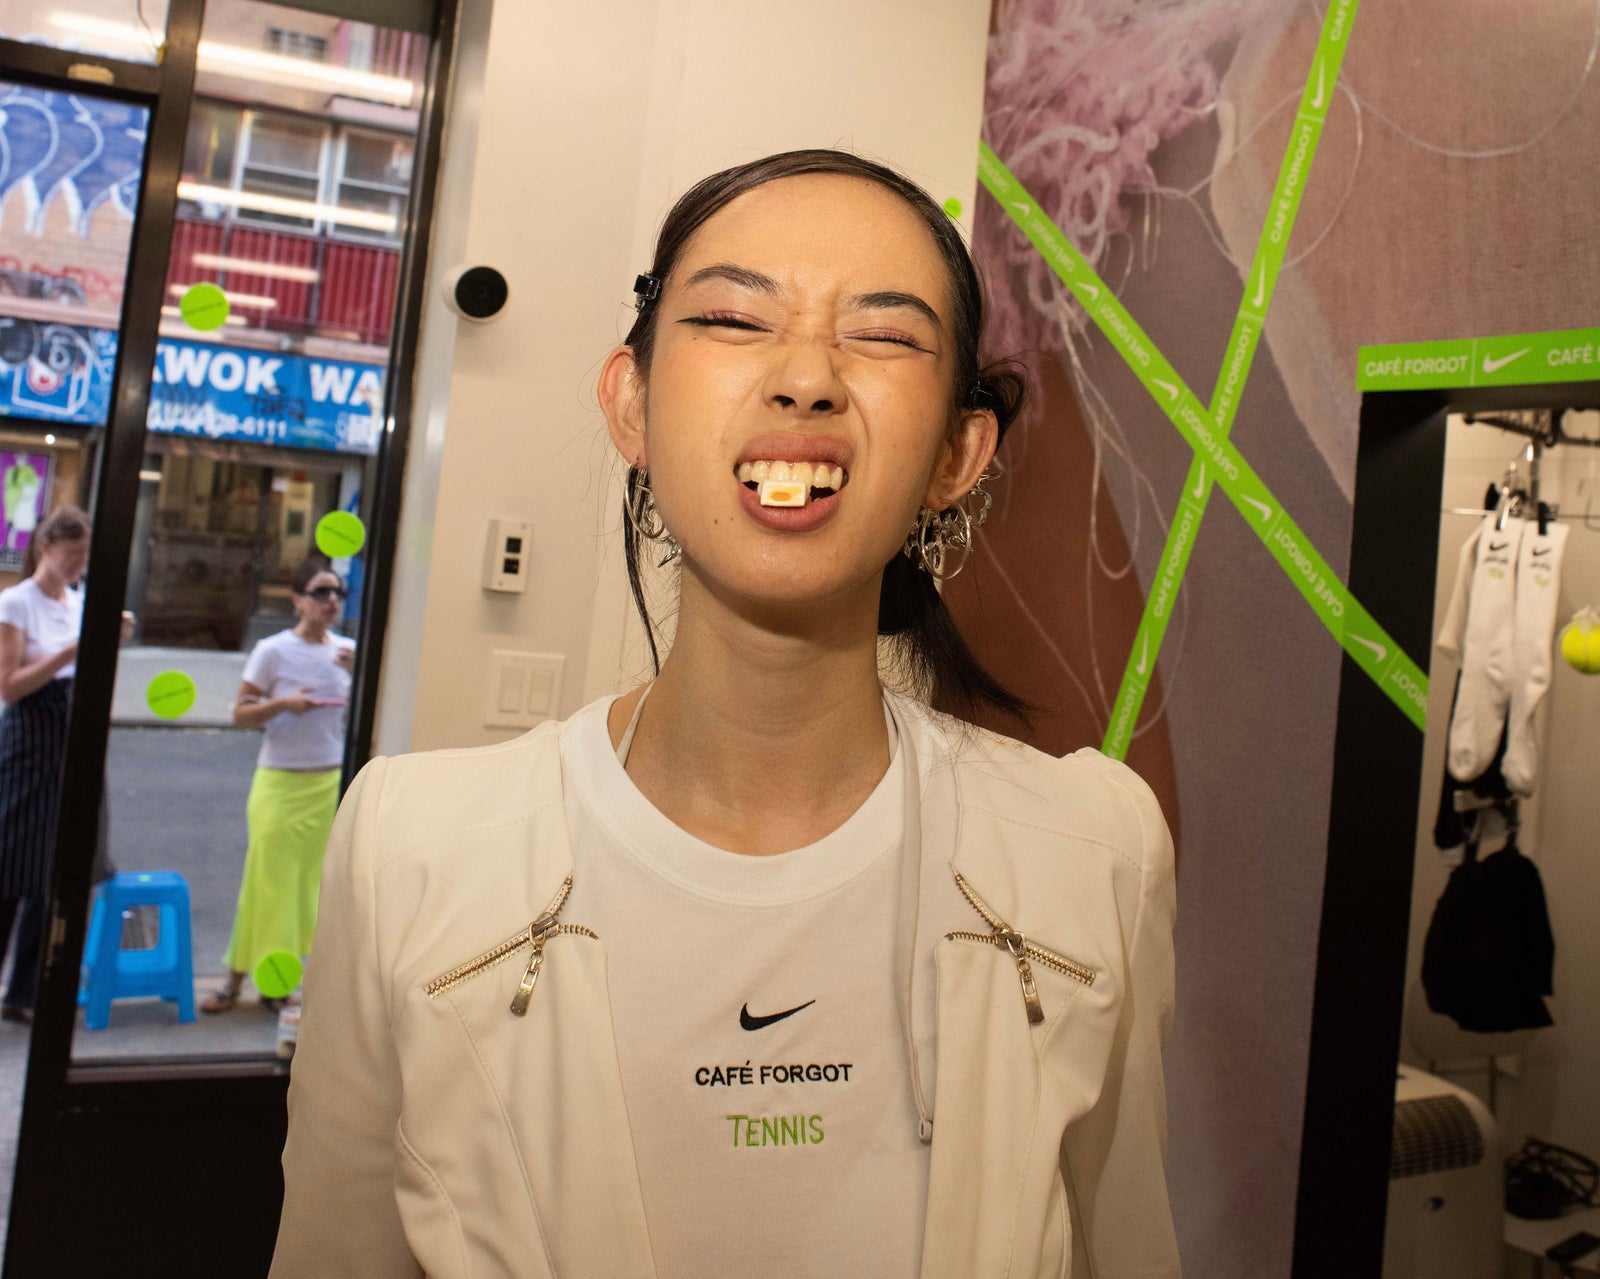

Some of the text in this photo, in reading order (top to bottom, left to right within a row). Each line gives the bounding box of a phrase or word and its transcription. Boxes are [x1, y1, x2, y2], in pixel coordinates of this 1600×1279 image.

[1284, 123, 1313, 197] FORGOT
[1215, 324, 1252, 428] AFÉ FORGOT
[1364, 355, 1469, 377] CAFÉ FORGOT
[1547, 342, 1593, 367] CAFÉ
[1166, 510, 1194, 577] FORGOT
[1273, 527, 1319, 584] FORGOT
[694, 1060, 853, 1087] CAFÉ FORGOT
[726, 1113, 825, 1148] TENNIS
